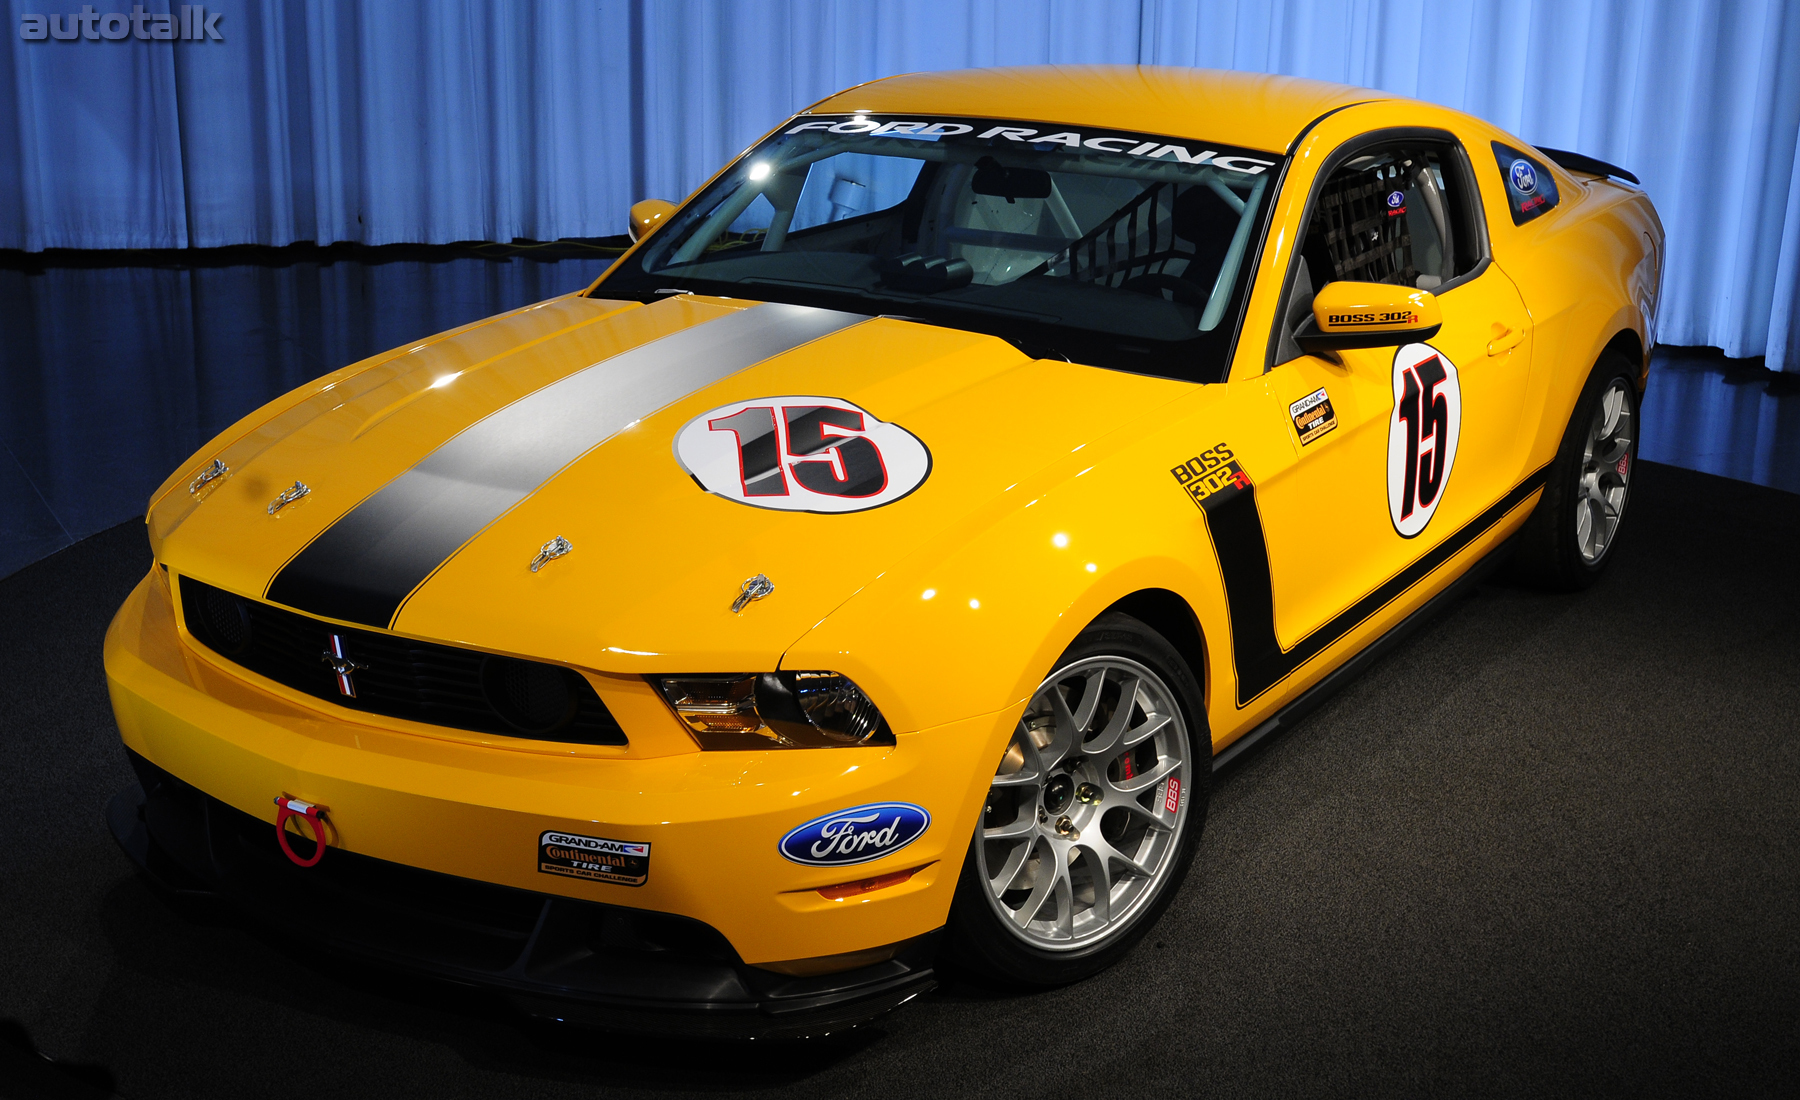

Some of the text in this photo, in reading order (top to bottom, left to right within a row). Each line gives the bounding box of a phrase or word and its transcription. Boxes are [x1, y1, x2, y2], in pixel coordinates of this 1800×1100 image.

[784, 120, 1276, 175] FORD RACING
[1514, 165, 1535, 190] Ford
[1328, 313, 1375, 323] BOSS
[1295, 404, 1327, 430] Continental
[1307, 416, 1325, 430] TIRE
[1398, 353, 1448, 523] 15
[707, 405, 889, 499] 15
[1169, 442, 1235, 486] BOSS
[1166, 778, 1180, 813] BBS
[548, 834, 624, 853] GRAND-AM
[810, 812, 902, 859] Ford
[545, 845, 627, 868] Continental
[570, 860, 613, 873] TIRE
[544, 864, 639, 884] SPORTS CAR CHALLENGE
